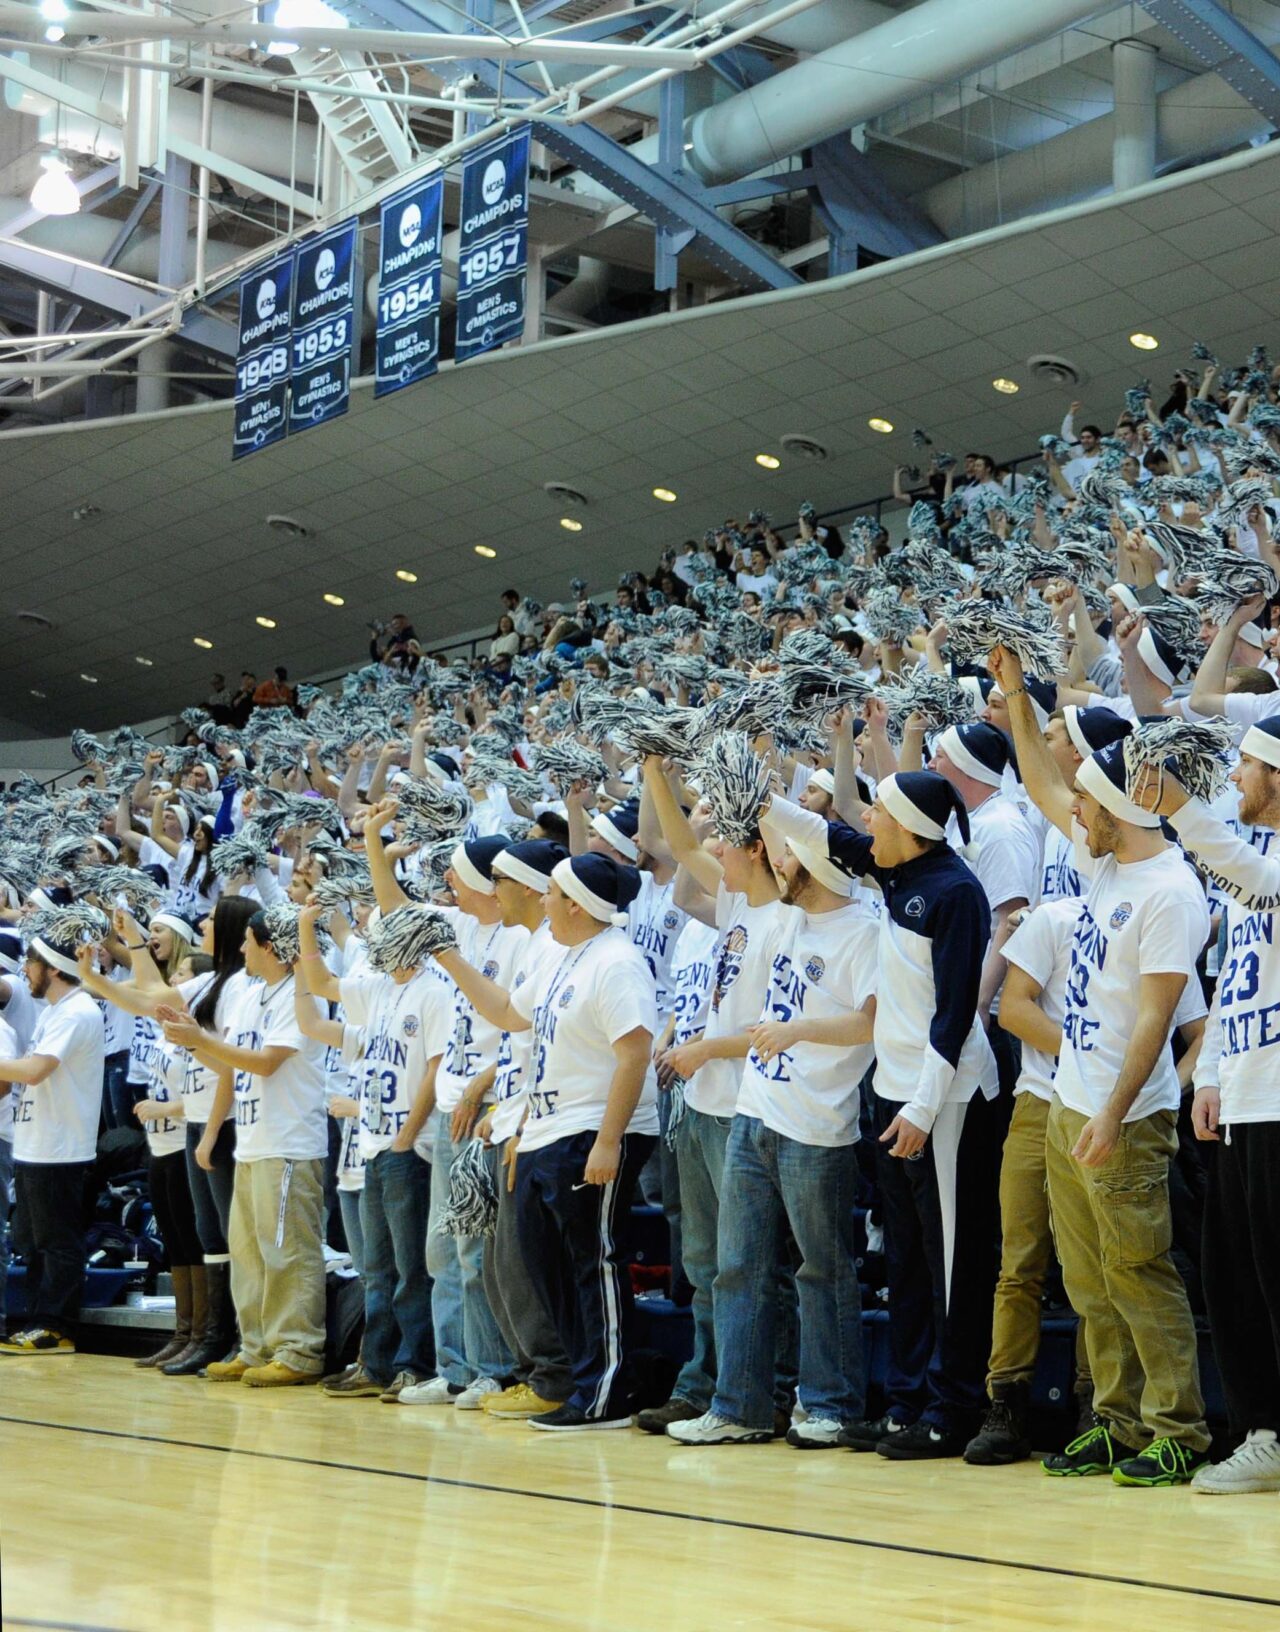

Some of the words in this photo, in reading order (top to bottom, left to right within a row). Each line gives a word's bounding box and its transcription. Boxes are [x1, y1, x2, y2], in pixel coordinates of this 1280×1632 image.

[464, 193, 523, 233] CHAMPIONS
[384, 236, 436, 274] CHAMPIONS
[462, 233, 521, 285] 1957
[299, 281, 349, 317] CHAMPIONS
[381, 277, 434, 322] 1954
[477, 293, 501, 313] MEN'S
[295, 319, 346, 363] 1953
[395, 331, 419, 351] MEN'S
[238, 347, 287, 391] 1948
[1042, 864, 1081, 897] ENN
[1200, 859, 1242, 899] LIONS
[634, 924, 668, 957] ENN
[1073, 903, 1108, 972] NN
[1220, 950, 1260, 1008] 23
